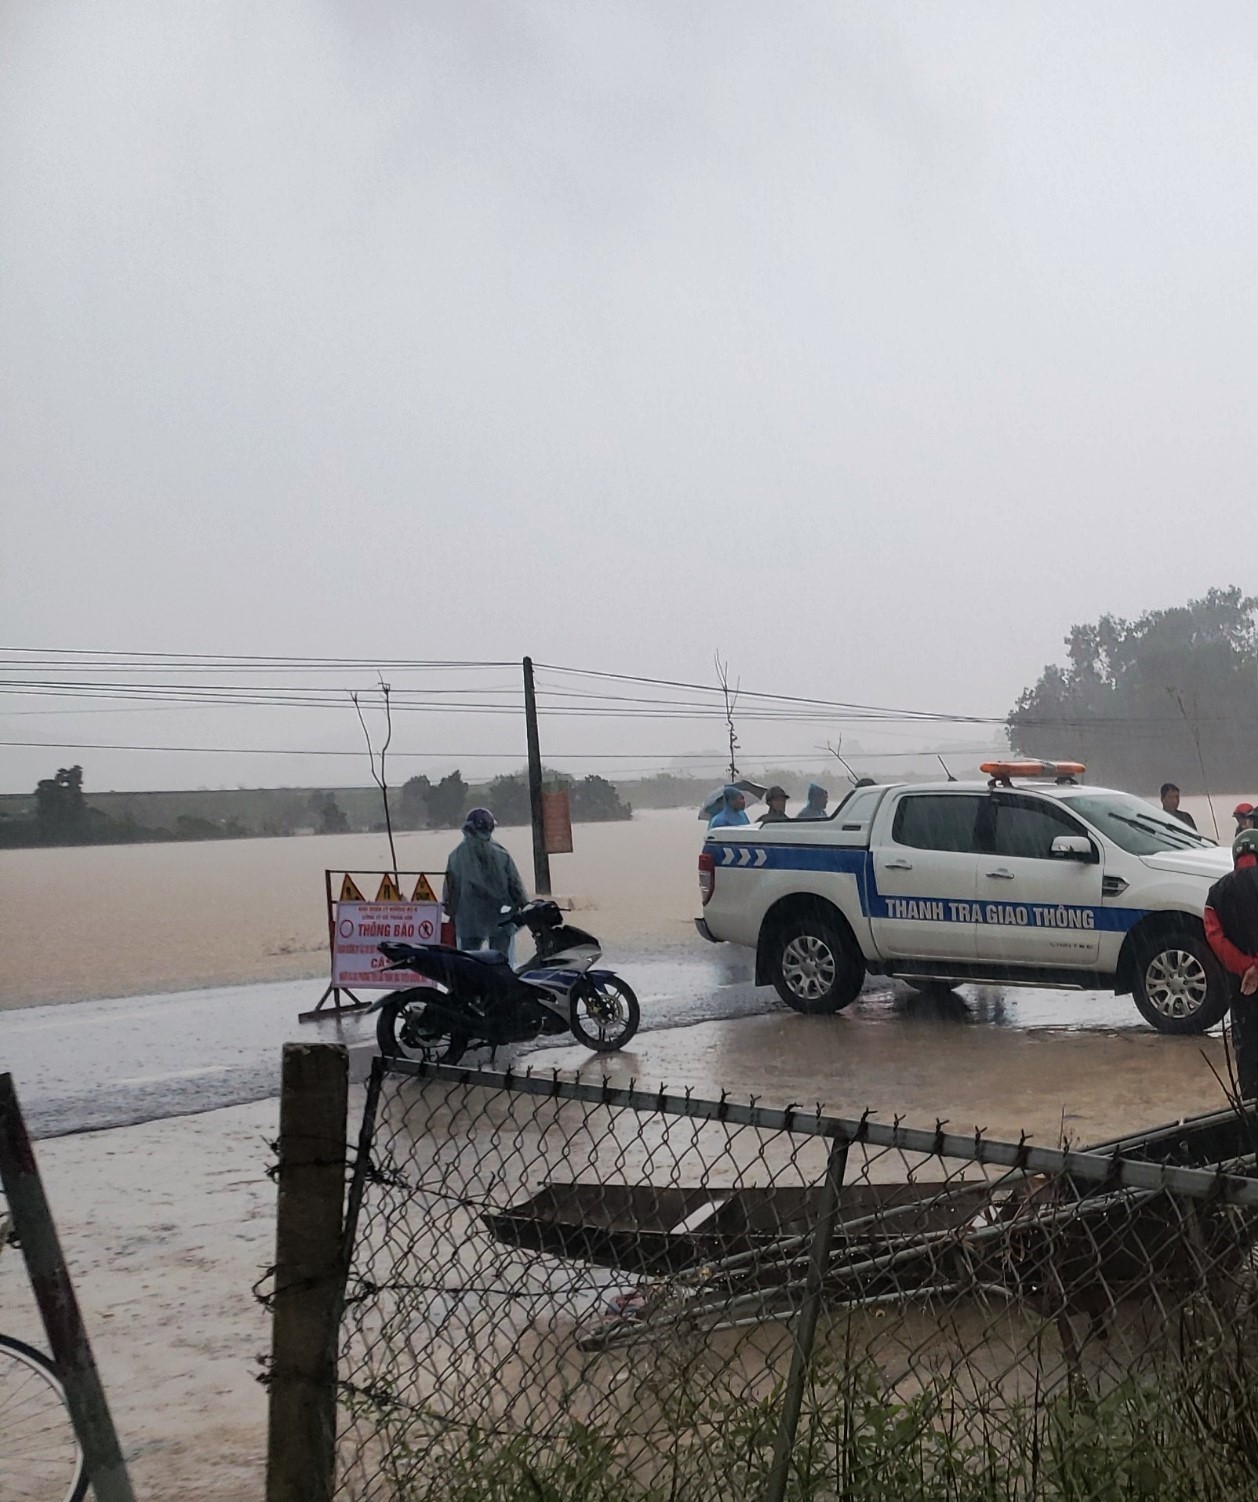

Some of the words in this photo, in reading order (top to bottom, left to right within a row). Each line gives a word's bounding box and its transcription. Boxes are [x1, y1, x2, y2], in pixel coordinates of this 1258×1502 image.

[885, 899, 944, 921] THANH
[948, 902, 984, 923] TRA
[986, 904, 1028, 925] GIAO
[1033, 904, 1095, 929] THÔNG
[358, 921, 391, 937] THÔNG
